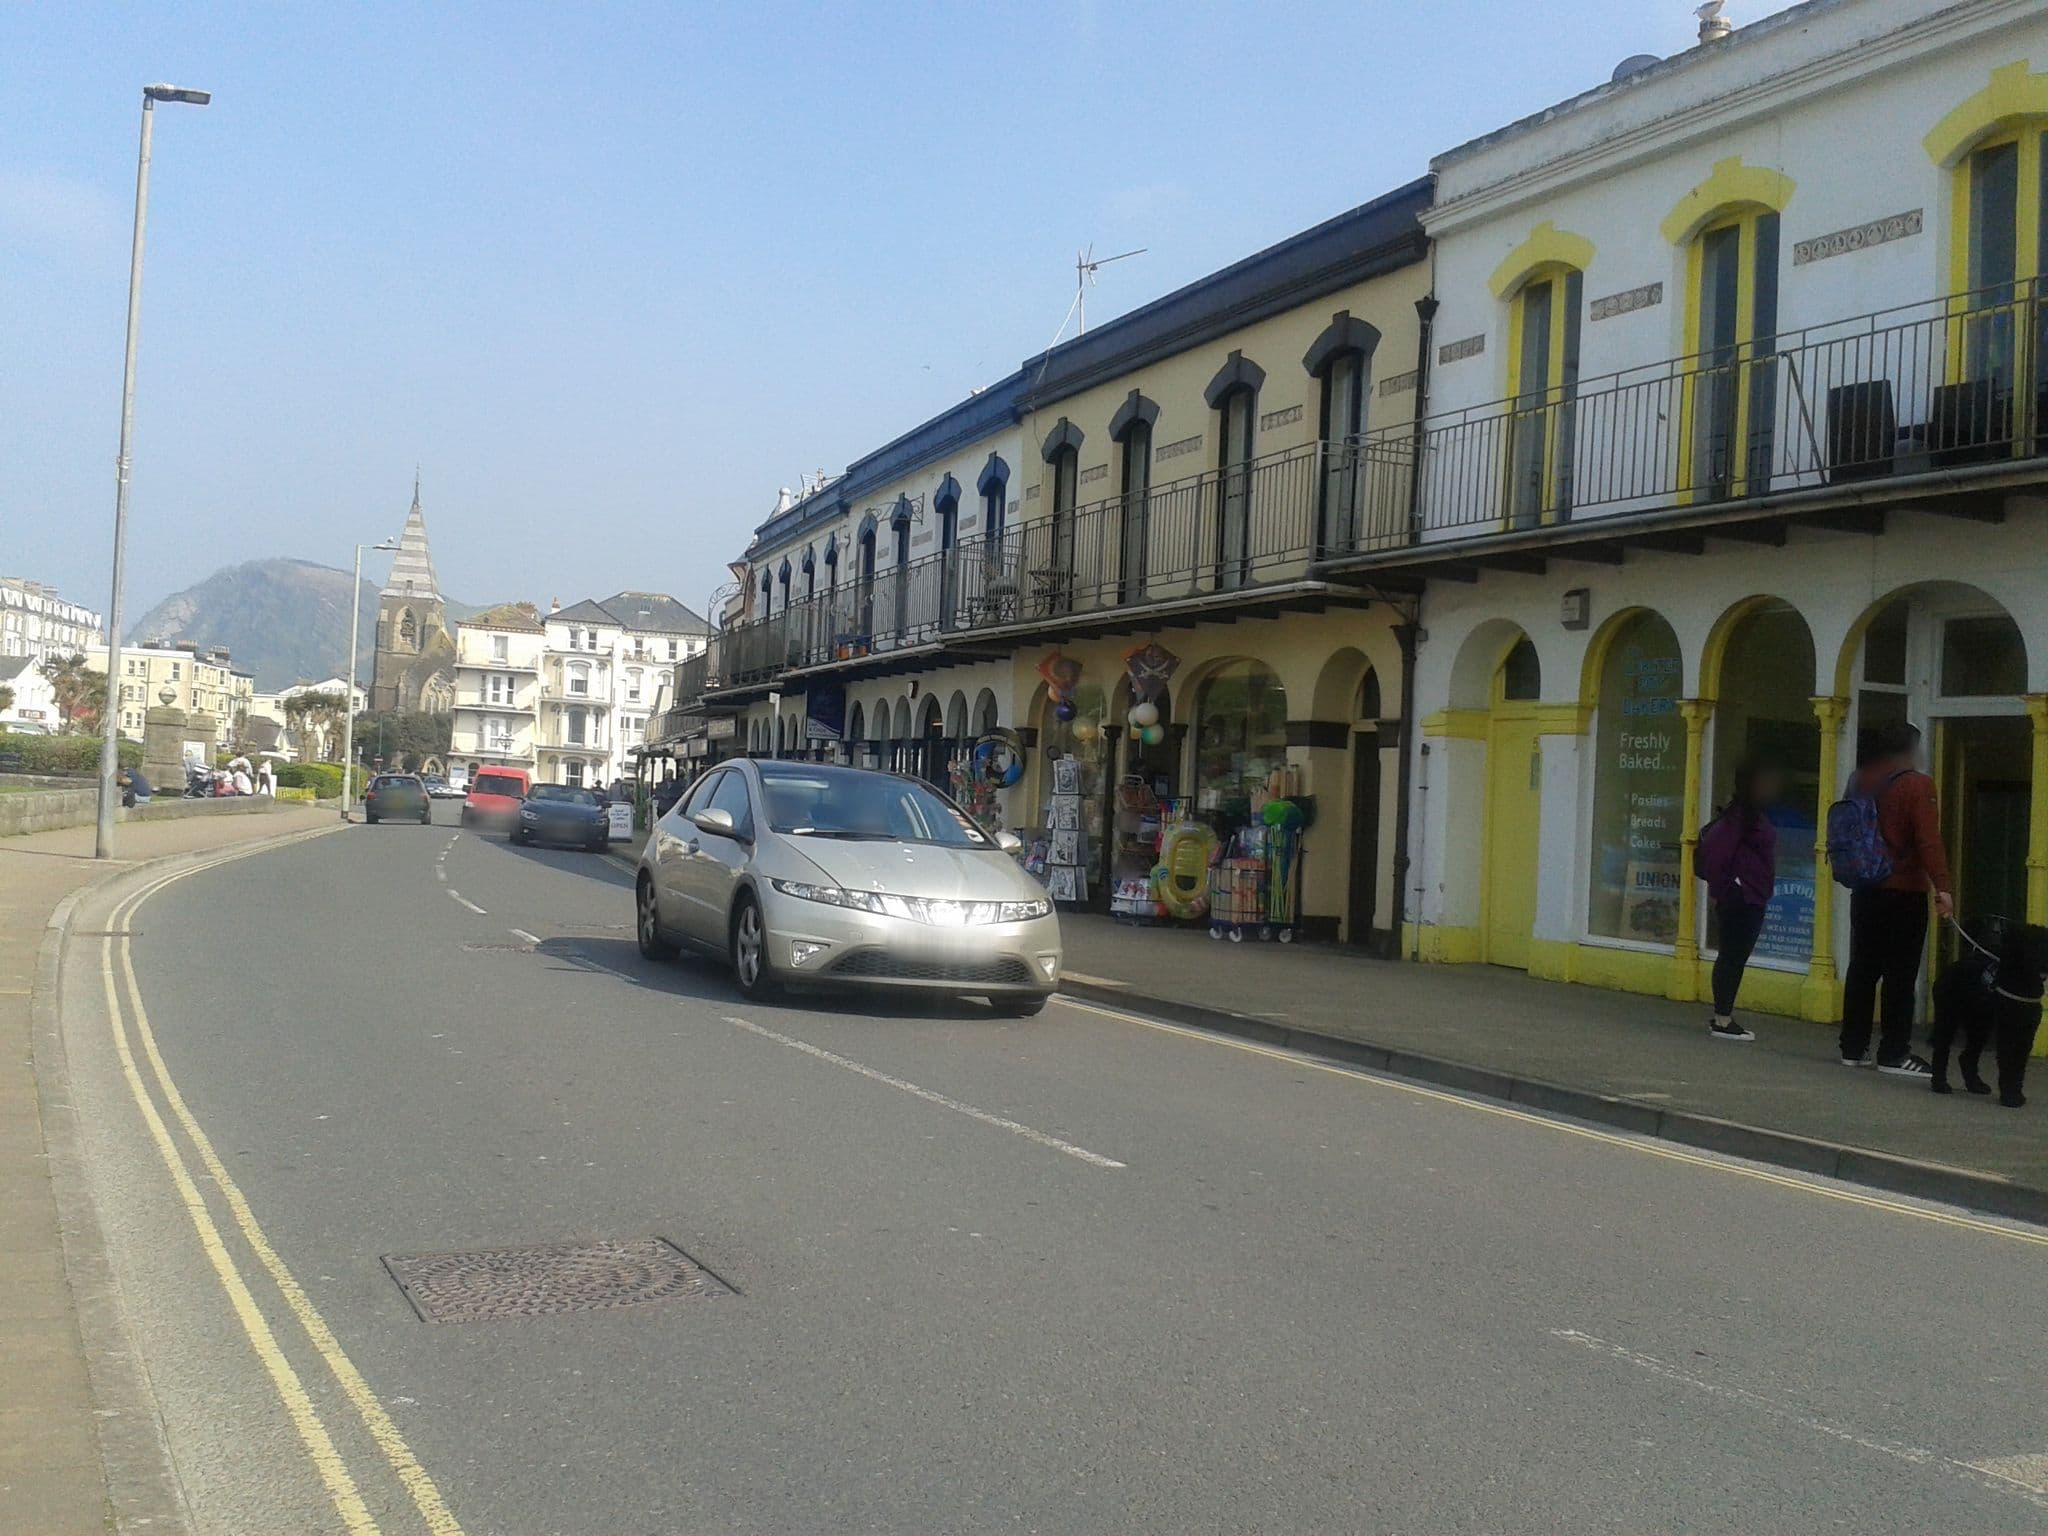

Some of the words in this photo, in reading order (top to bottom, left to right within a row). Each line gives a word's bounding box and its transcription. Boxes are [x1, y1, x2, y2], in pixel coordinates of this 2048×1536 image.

[1619, 732, 1671, 753] Freshly
[1630, 813, 1666, 829] Breads
[1630, 835, 1661, 849] Cakes
[1636, 871, 1681, 888] UNION
